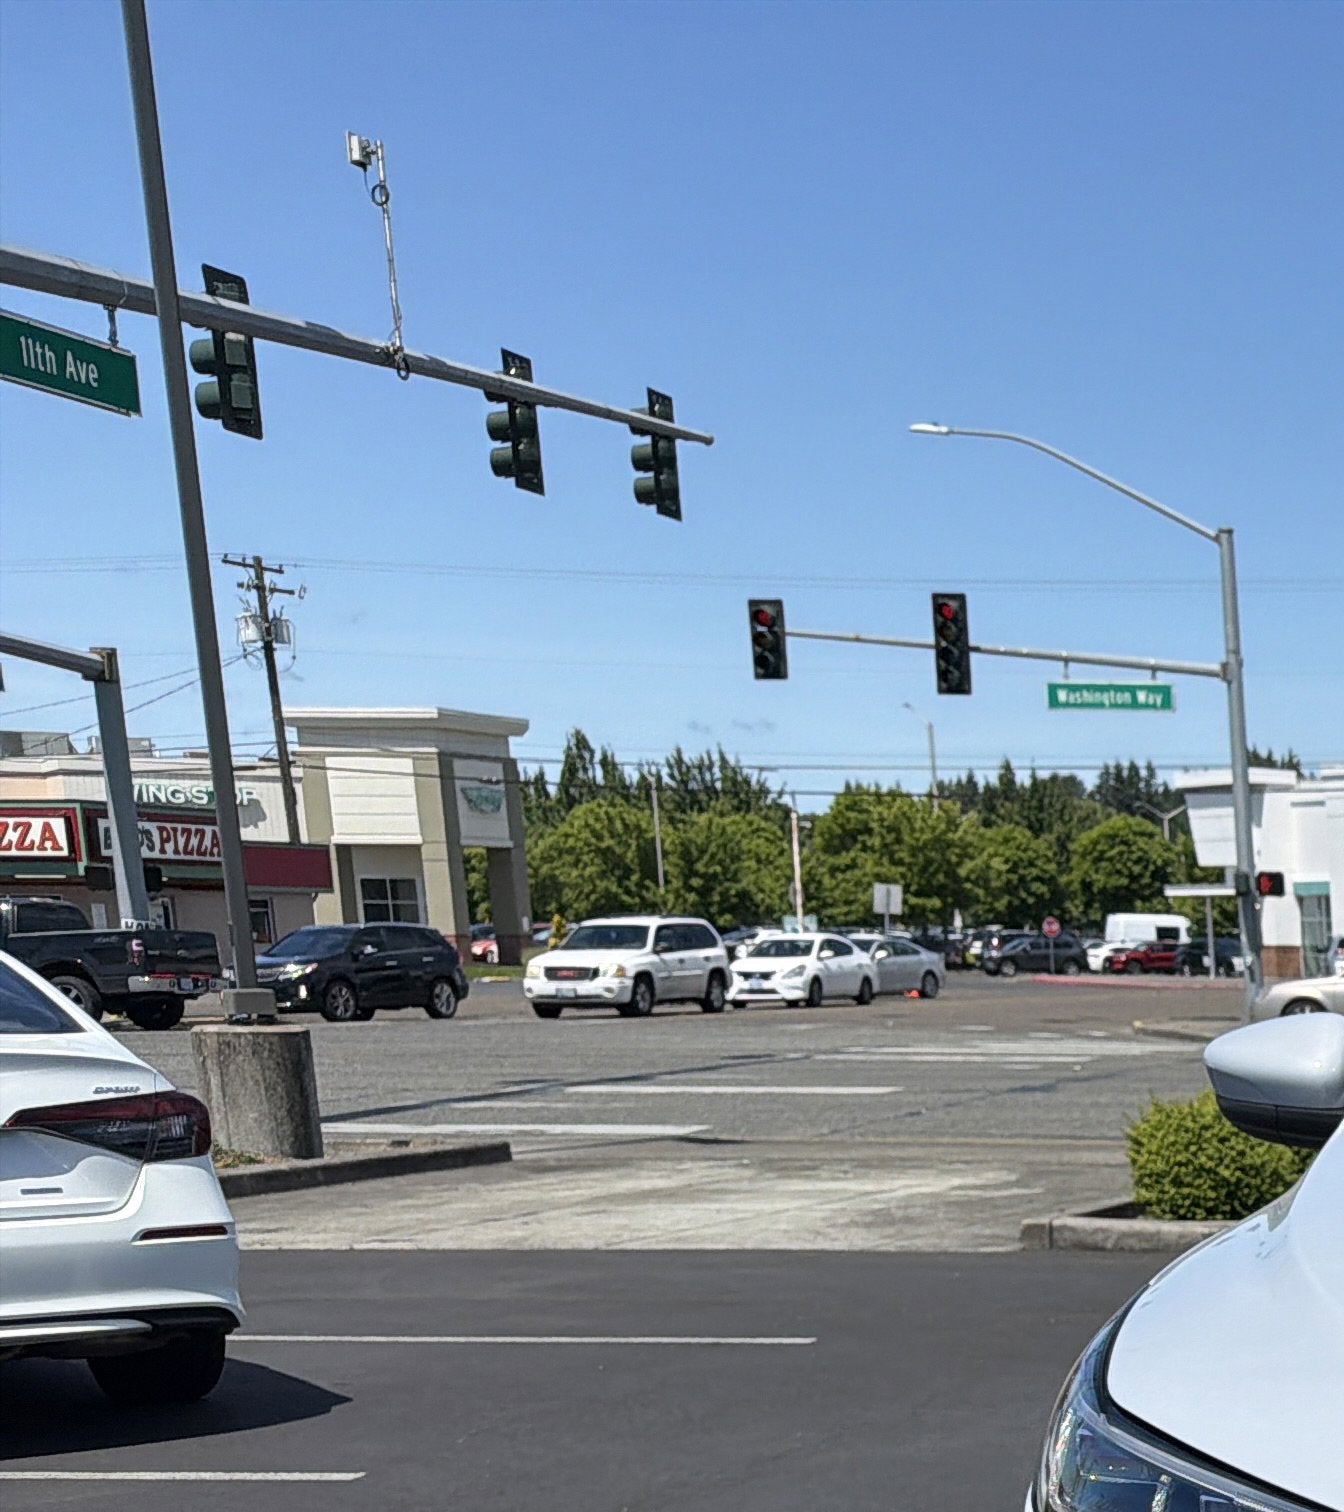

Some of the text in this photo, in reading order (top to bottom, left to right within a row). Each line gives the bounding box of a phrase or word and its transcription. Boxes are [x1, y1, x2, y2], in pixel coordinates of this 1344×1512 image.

[19, 335, 99, 388] 11th Ave
[1056, 688, 1163, 708] Washington Way
